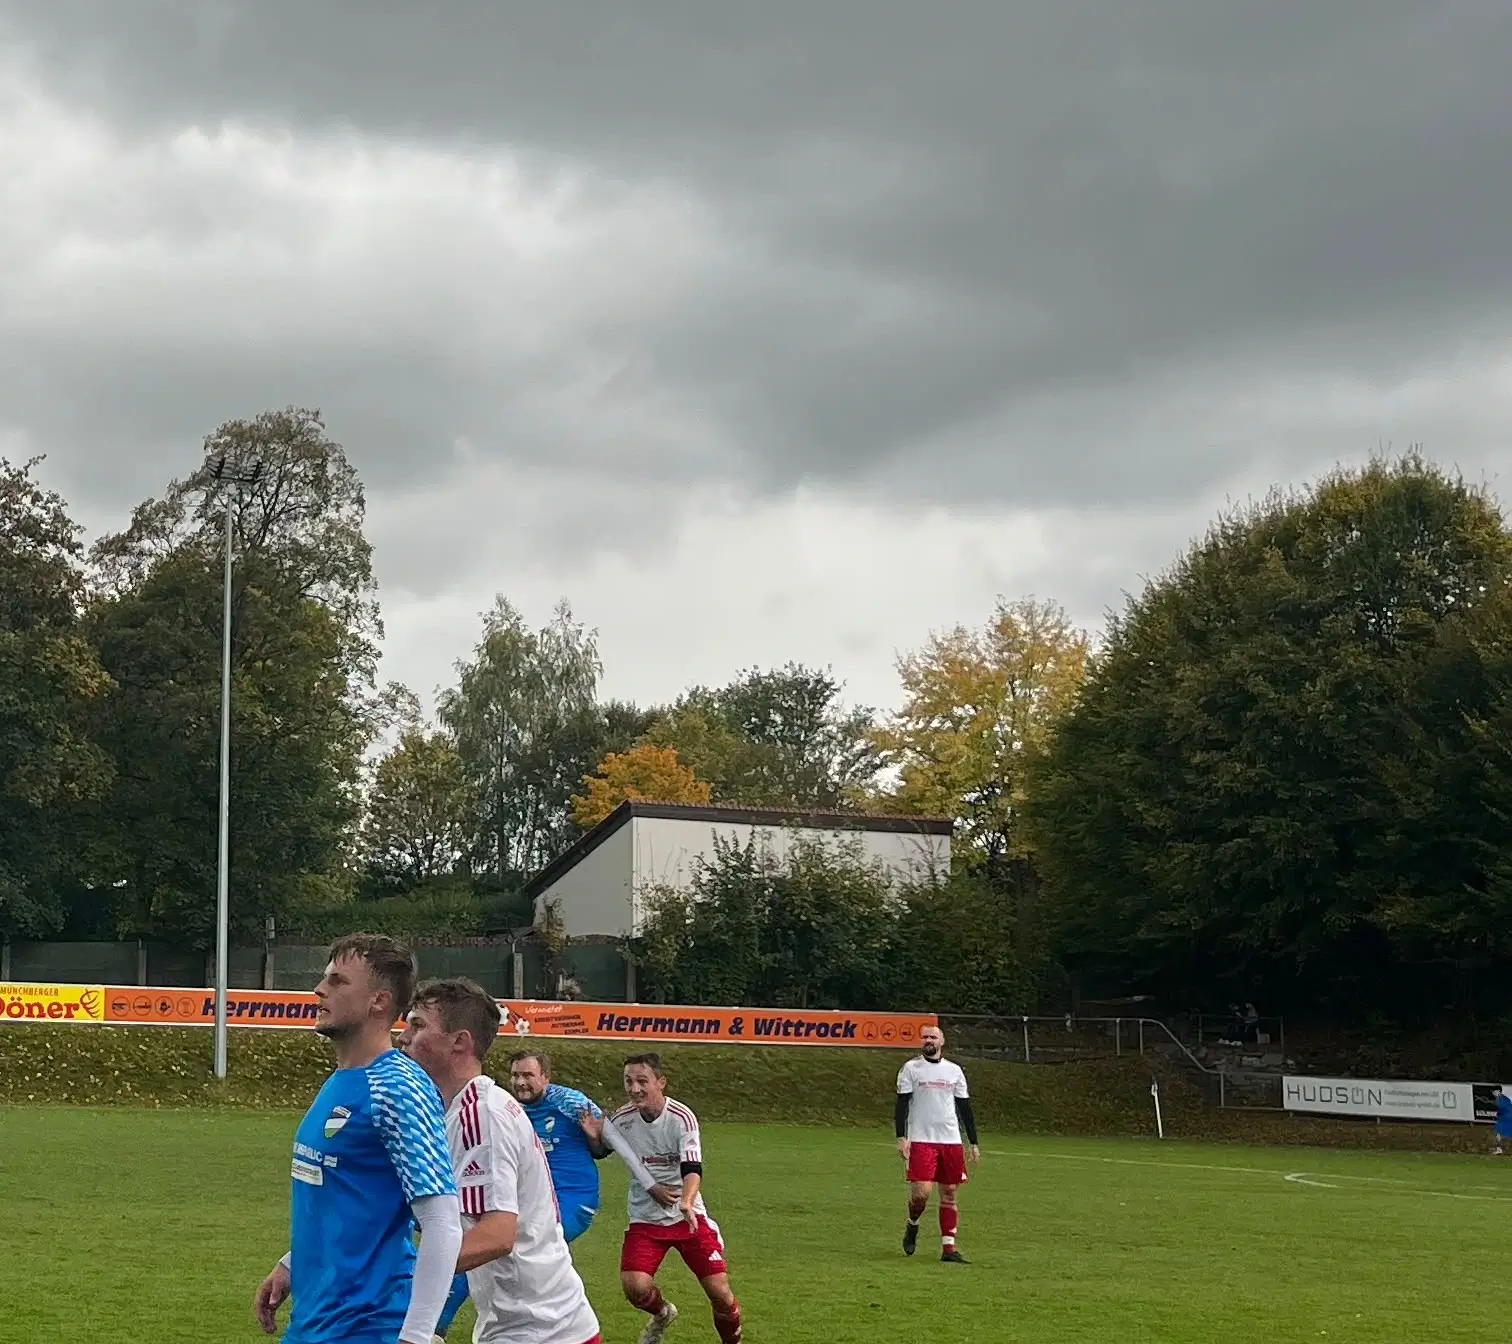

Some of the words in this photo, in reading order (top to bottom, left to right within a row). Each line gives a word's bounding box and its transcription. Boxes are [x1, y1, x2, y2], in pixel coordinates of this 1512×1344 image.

[0, 986, 58, 996] MÜNCHBERGER
[202, 997, 318, 1019] Herrman
[596, 1013, 721, 1035] Herrmann
[728, 1017, 744, 1036] &
[754, 1016, 859, 1039] Wittrock
[1287, 1083, 1382, 1106] HUDSON
